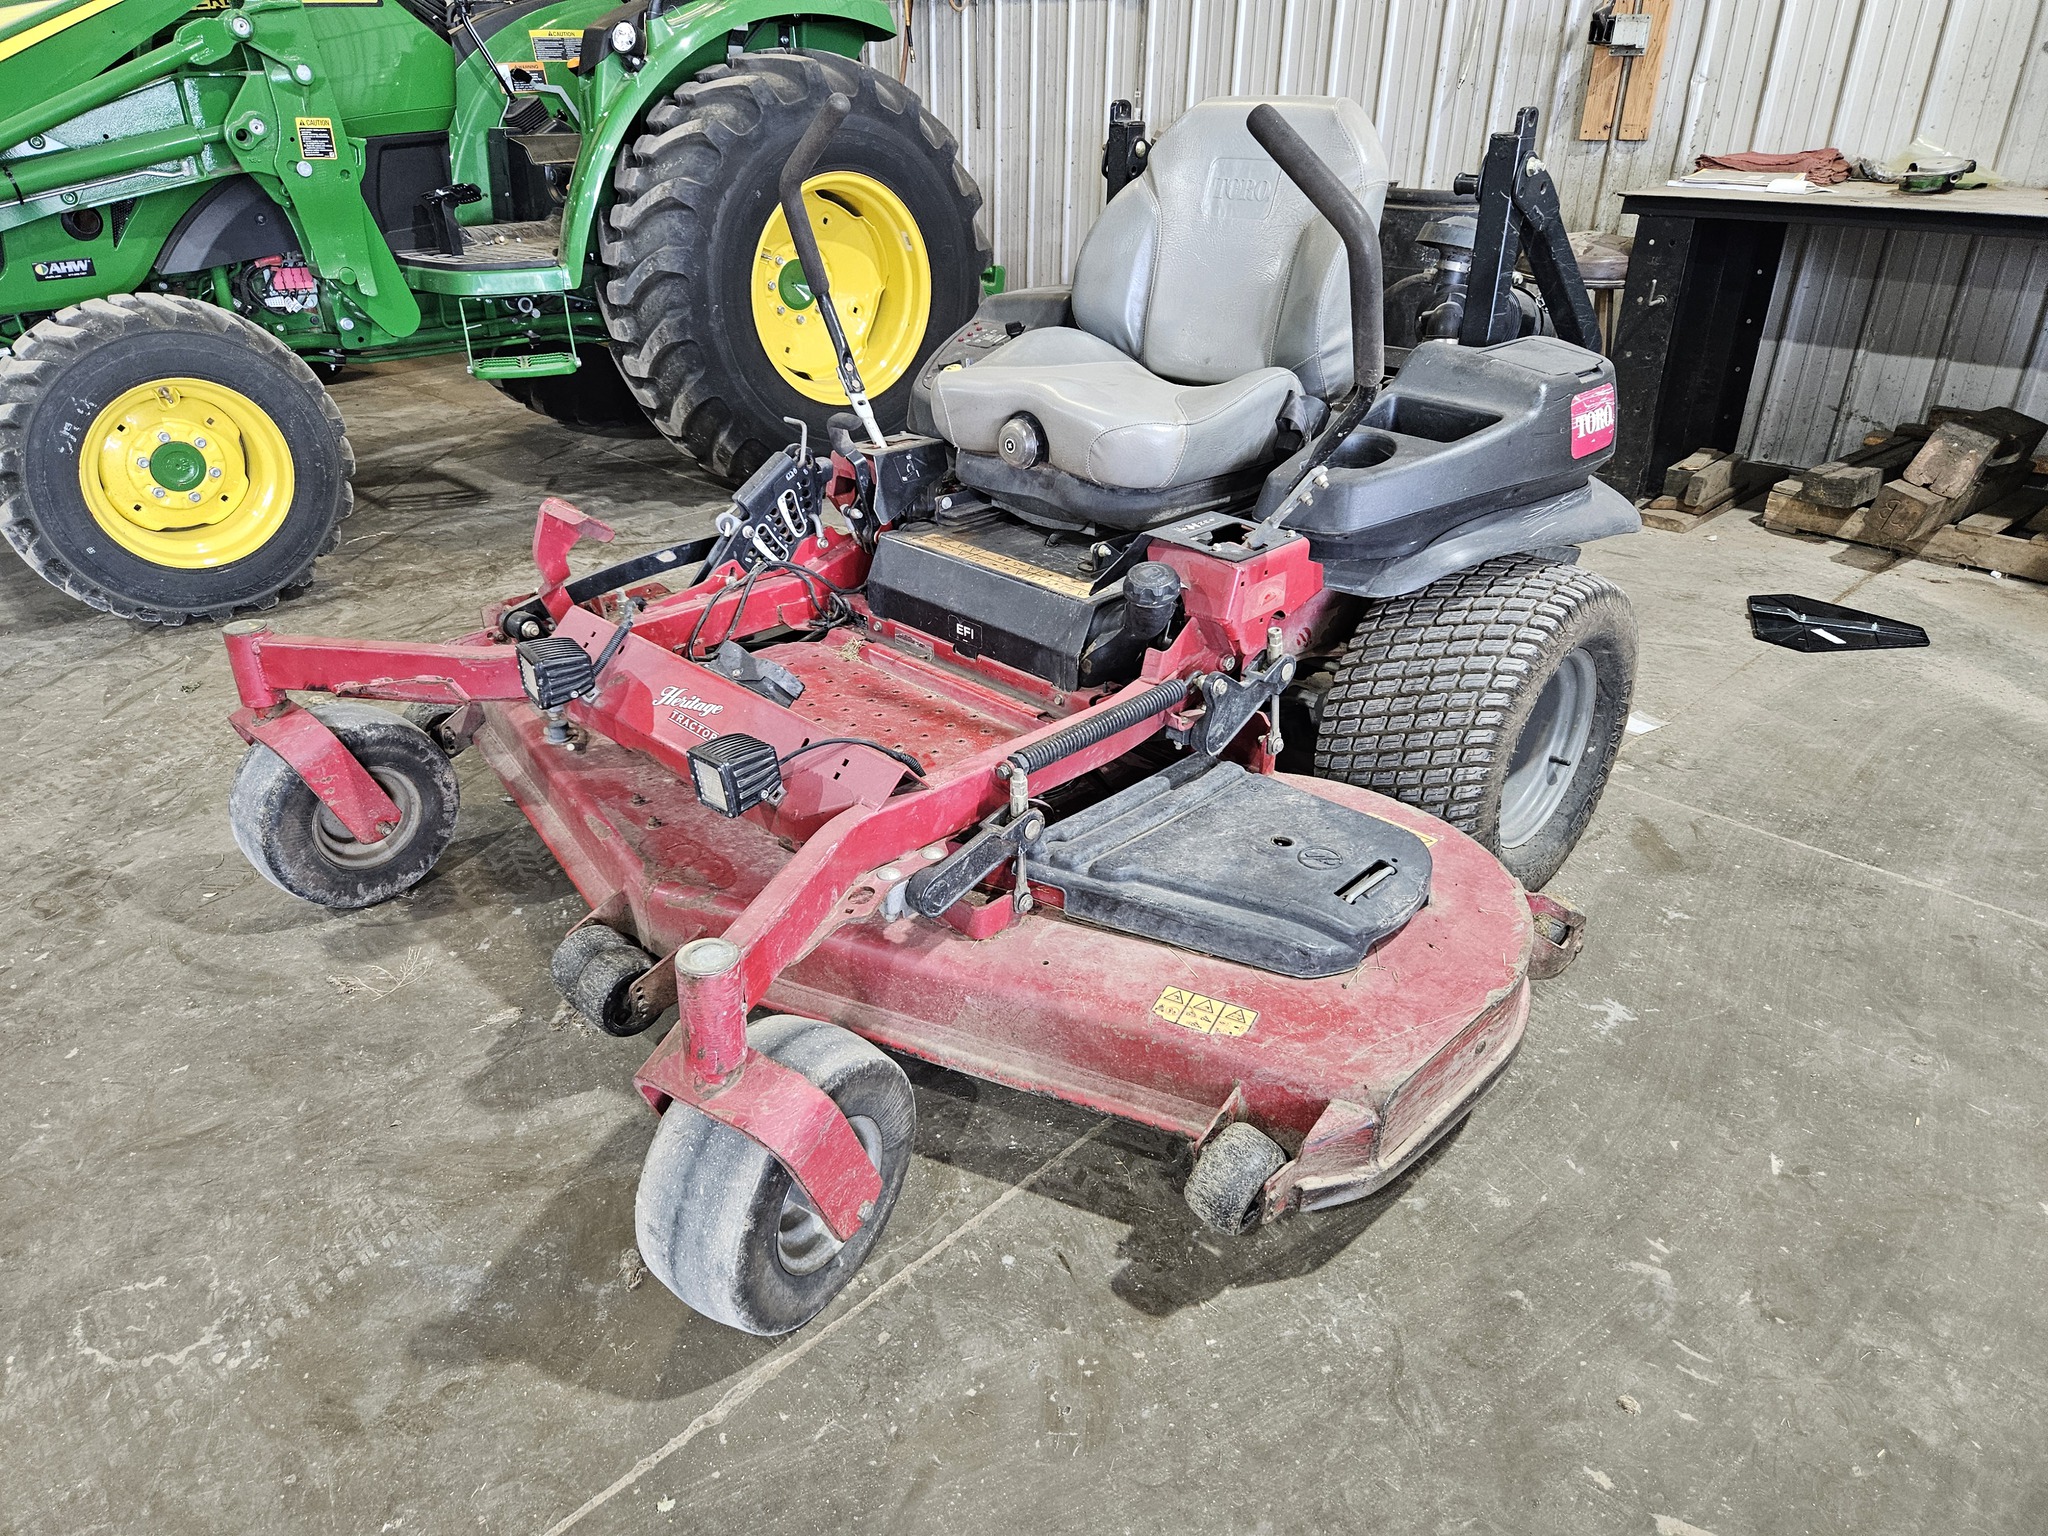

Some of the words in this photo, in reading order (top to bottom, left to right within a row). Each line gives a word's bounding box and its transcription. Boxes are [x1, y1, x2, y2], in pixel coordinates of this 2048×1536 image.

[1211, 177, 1271, 202] TORO
[49, 260, 88, 274] AHW
[1575, 404, 1614, 438] TORO
[956, 623, 974, 640] EFI
[652, 686, 724, 717] Heritage
